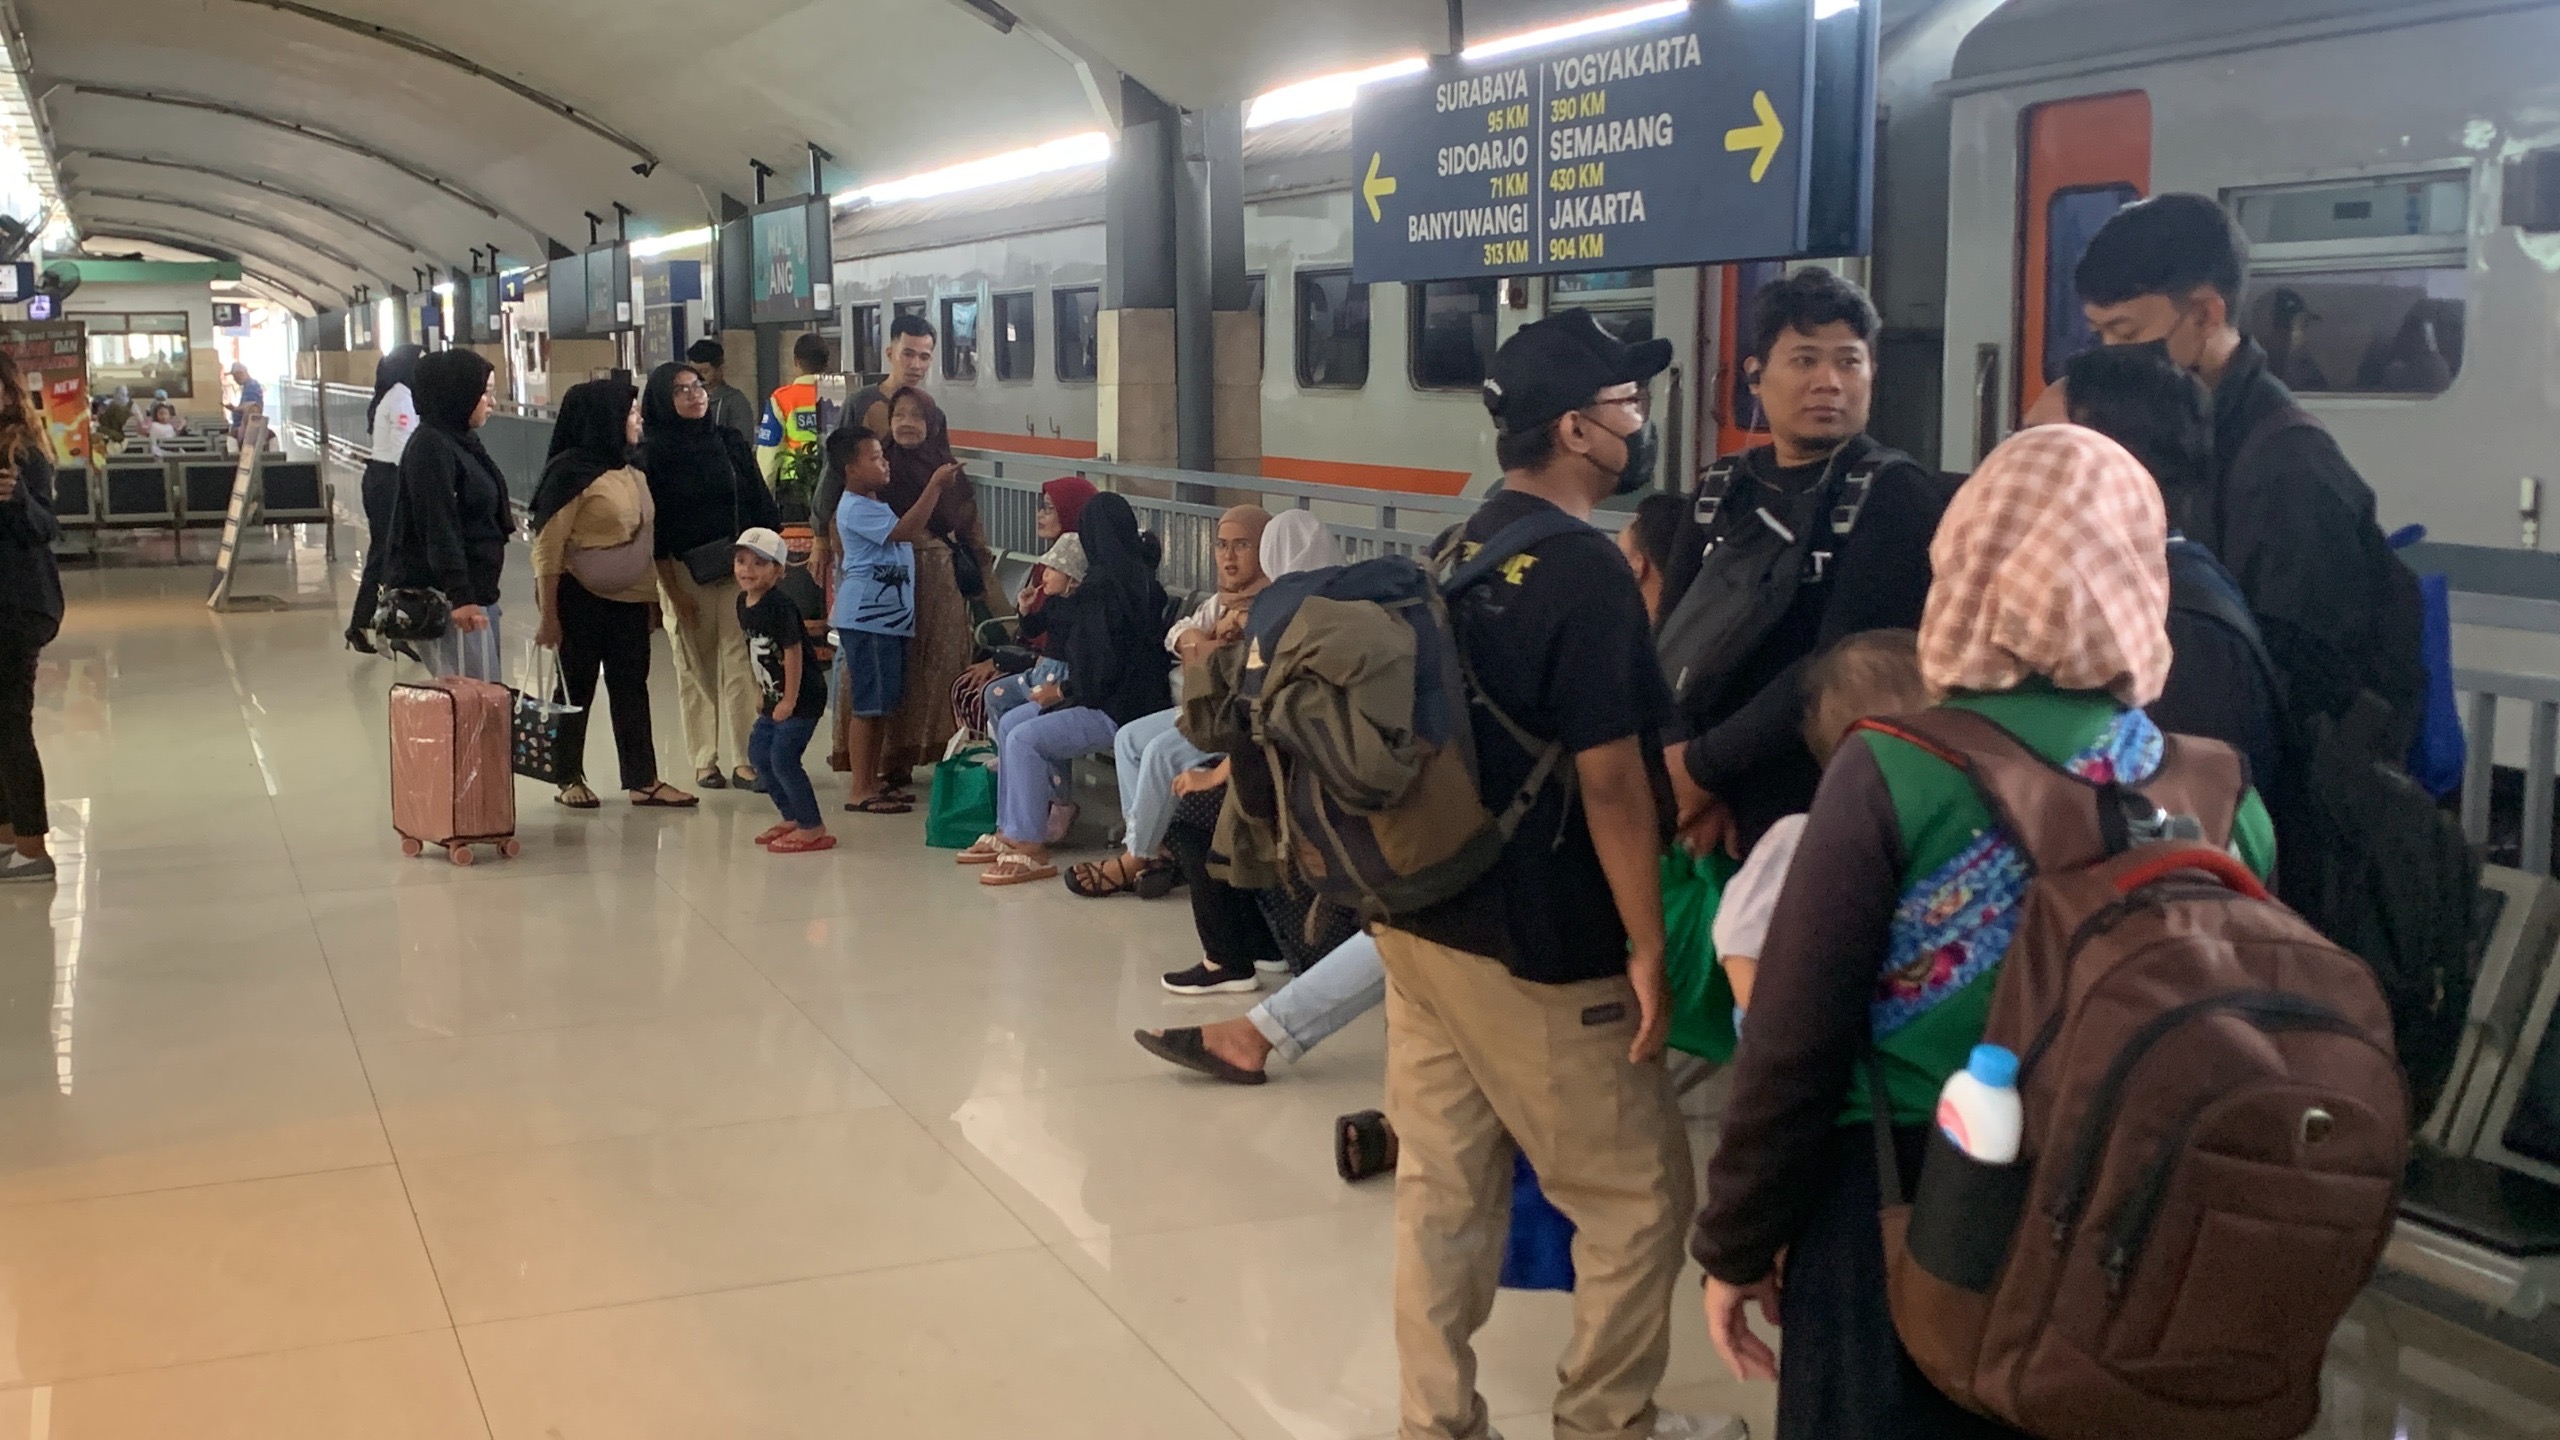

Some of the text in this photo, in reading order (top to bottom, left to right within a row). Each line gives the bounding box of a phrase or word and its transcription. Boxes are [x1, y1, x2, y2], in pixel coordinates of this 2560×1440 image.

[1552, 33, 1701, 91] YOGYAKARTA
[1436, 68, 1529, 113] SURABAYA
[1550, 89, 1606, 123] 390 KM
[1487, 103, 1529, 133] 95 KM
[1550, 112, 1673, 161] SEMARANG
[1437, 135, 1529, 177] SIDOARJO
[1490, 171, 1529, 199] 71 KM
[1550, 161, 1604, 192] 430 KM
[1408, 202, 1529, 243] BANYUWANGI
[1549, 190, 1646, 230] JAKARTA
[1483, 239, 1529, 265] 313 KM
[1550, 233, 1604, 261] 904 KM
[506, 282, 516, 298] 1
[769, 261, 794, 295] ANG
[53, 379, 80, 395] NEW
